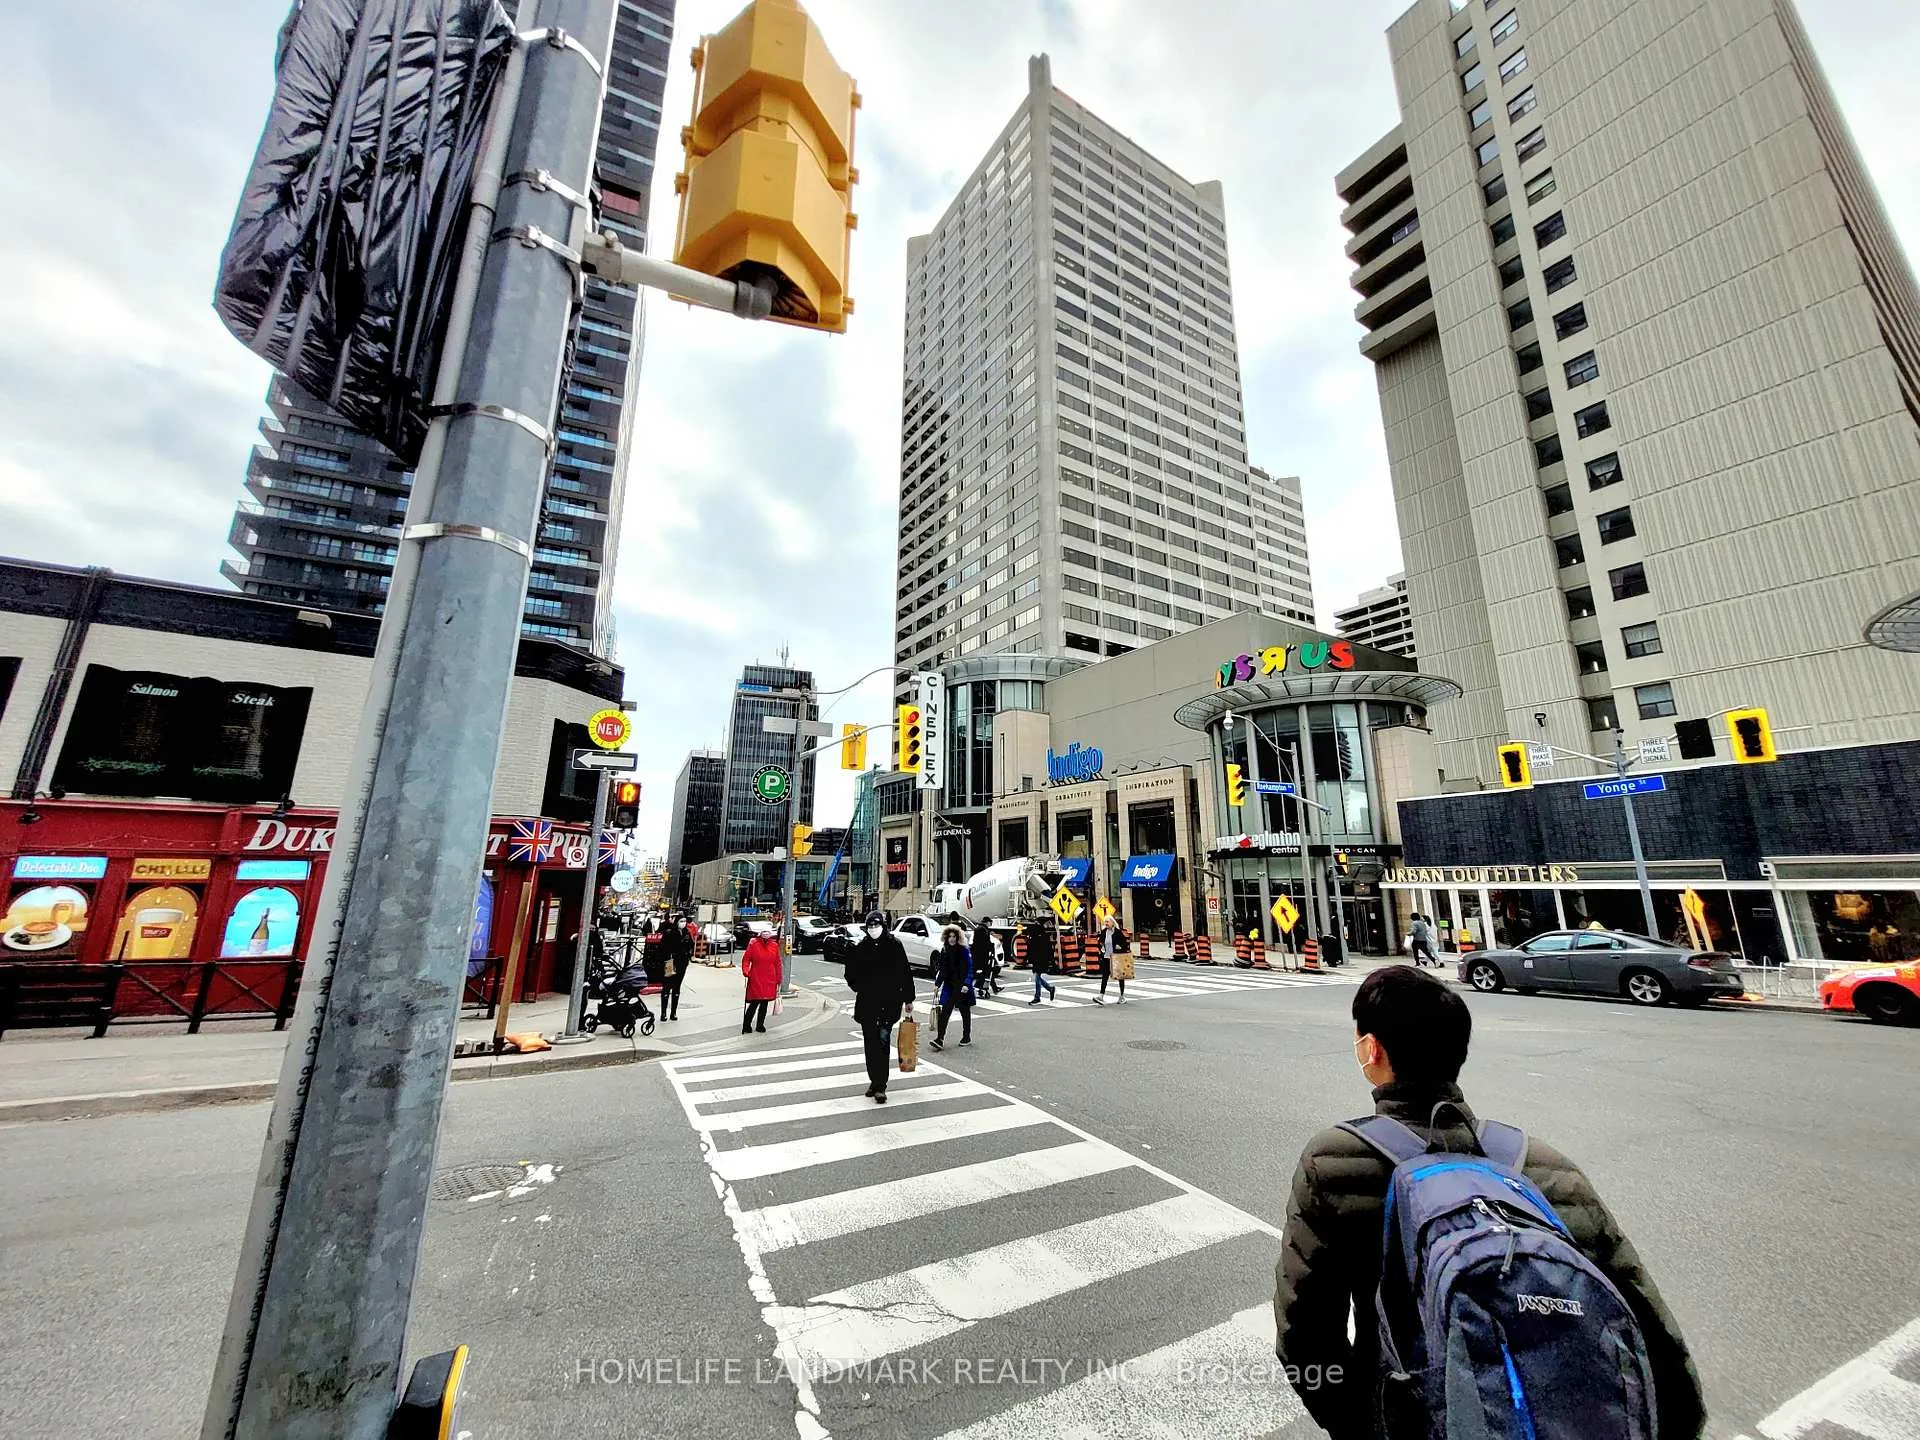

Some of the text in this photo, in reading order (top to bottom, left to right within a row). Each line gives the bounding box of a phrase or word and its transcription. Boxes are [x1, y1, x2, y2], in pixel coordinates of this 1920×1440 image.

[129, 683, 179, 697] Salmon
[232, 693, 276, 706] Steak
[597, 722, 623, 736] NEW
[924, 676, 938, 785] CINEPLEX
[1641, 738, 1664, 747] THREE
[1531, 747, 1548, 755] THREE
[1643, 746, 1666, 754] PHASE
[1047, 742, 1103, 781] Indigo
[1644, 754, 1669, 762] SIGNAL
[765, 775, 780, 790] P
[1125, 777, 1175, 791] INSPIRATION
[1597, 780, 1636, 794] Yonge
[1055, 790, 1092, 801] CREATIVITY
[243, 820, 337, 851] DUK
[1252, 830, 1300, 850] eglinton
[1133, 864, 1158, 879] Indigo
[1384, 865, 1579, 883] URBAN OUTFITTERS
[1517, 1293, 1584, 1316] JANSPORT
